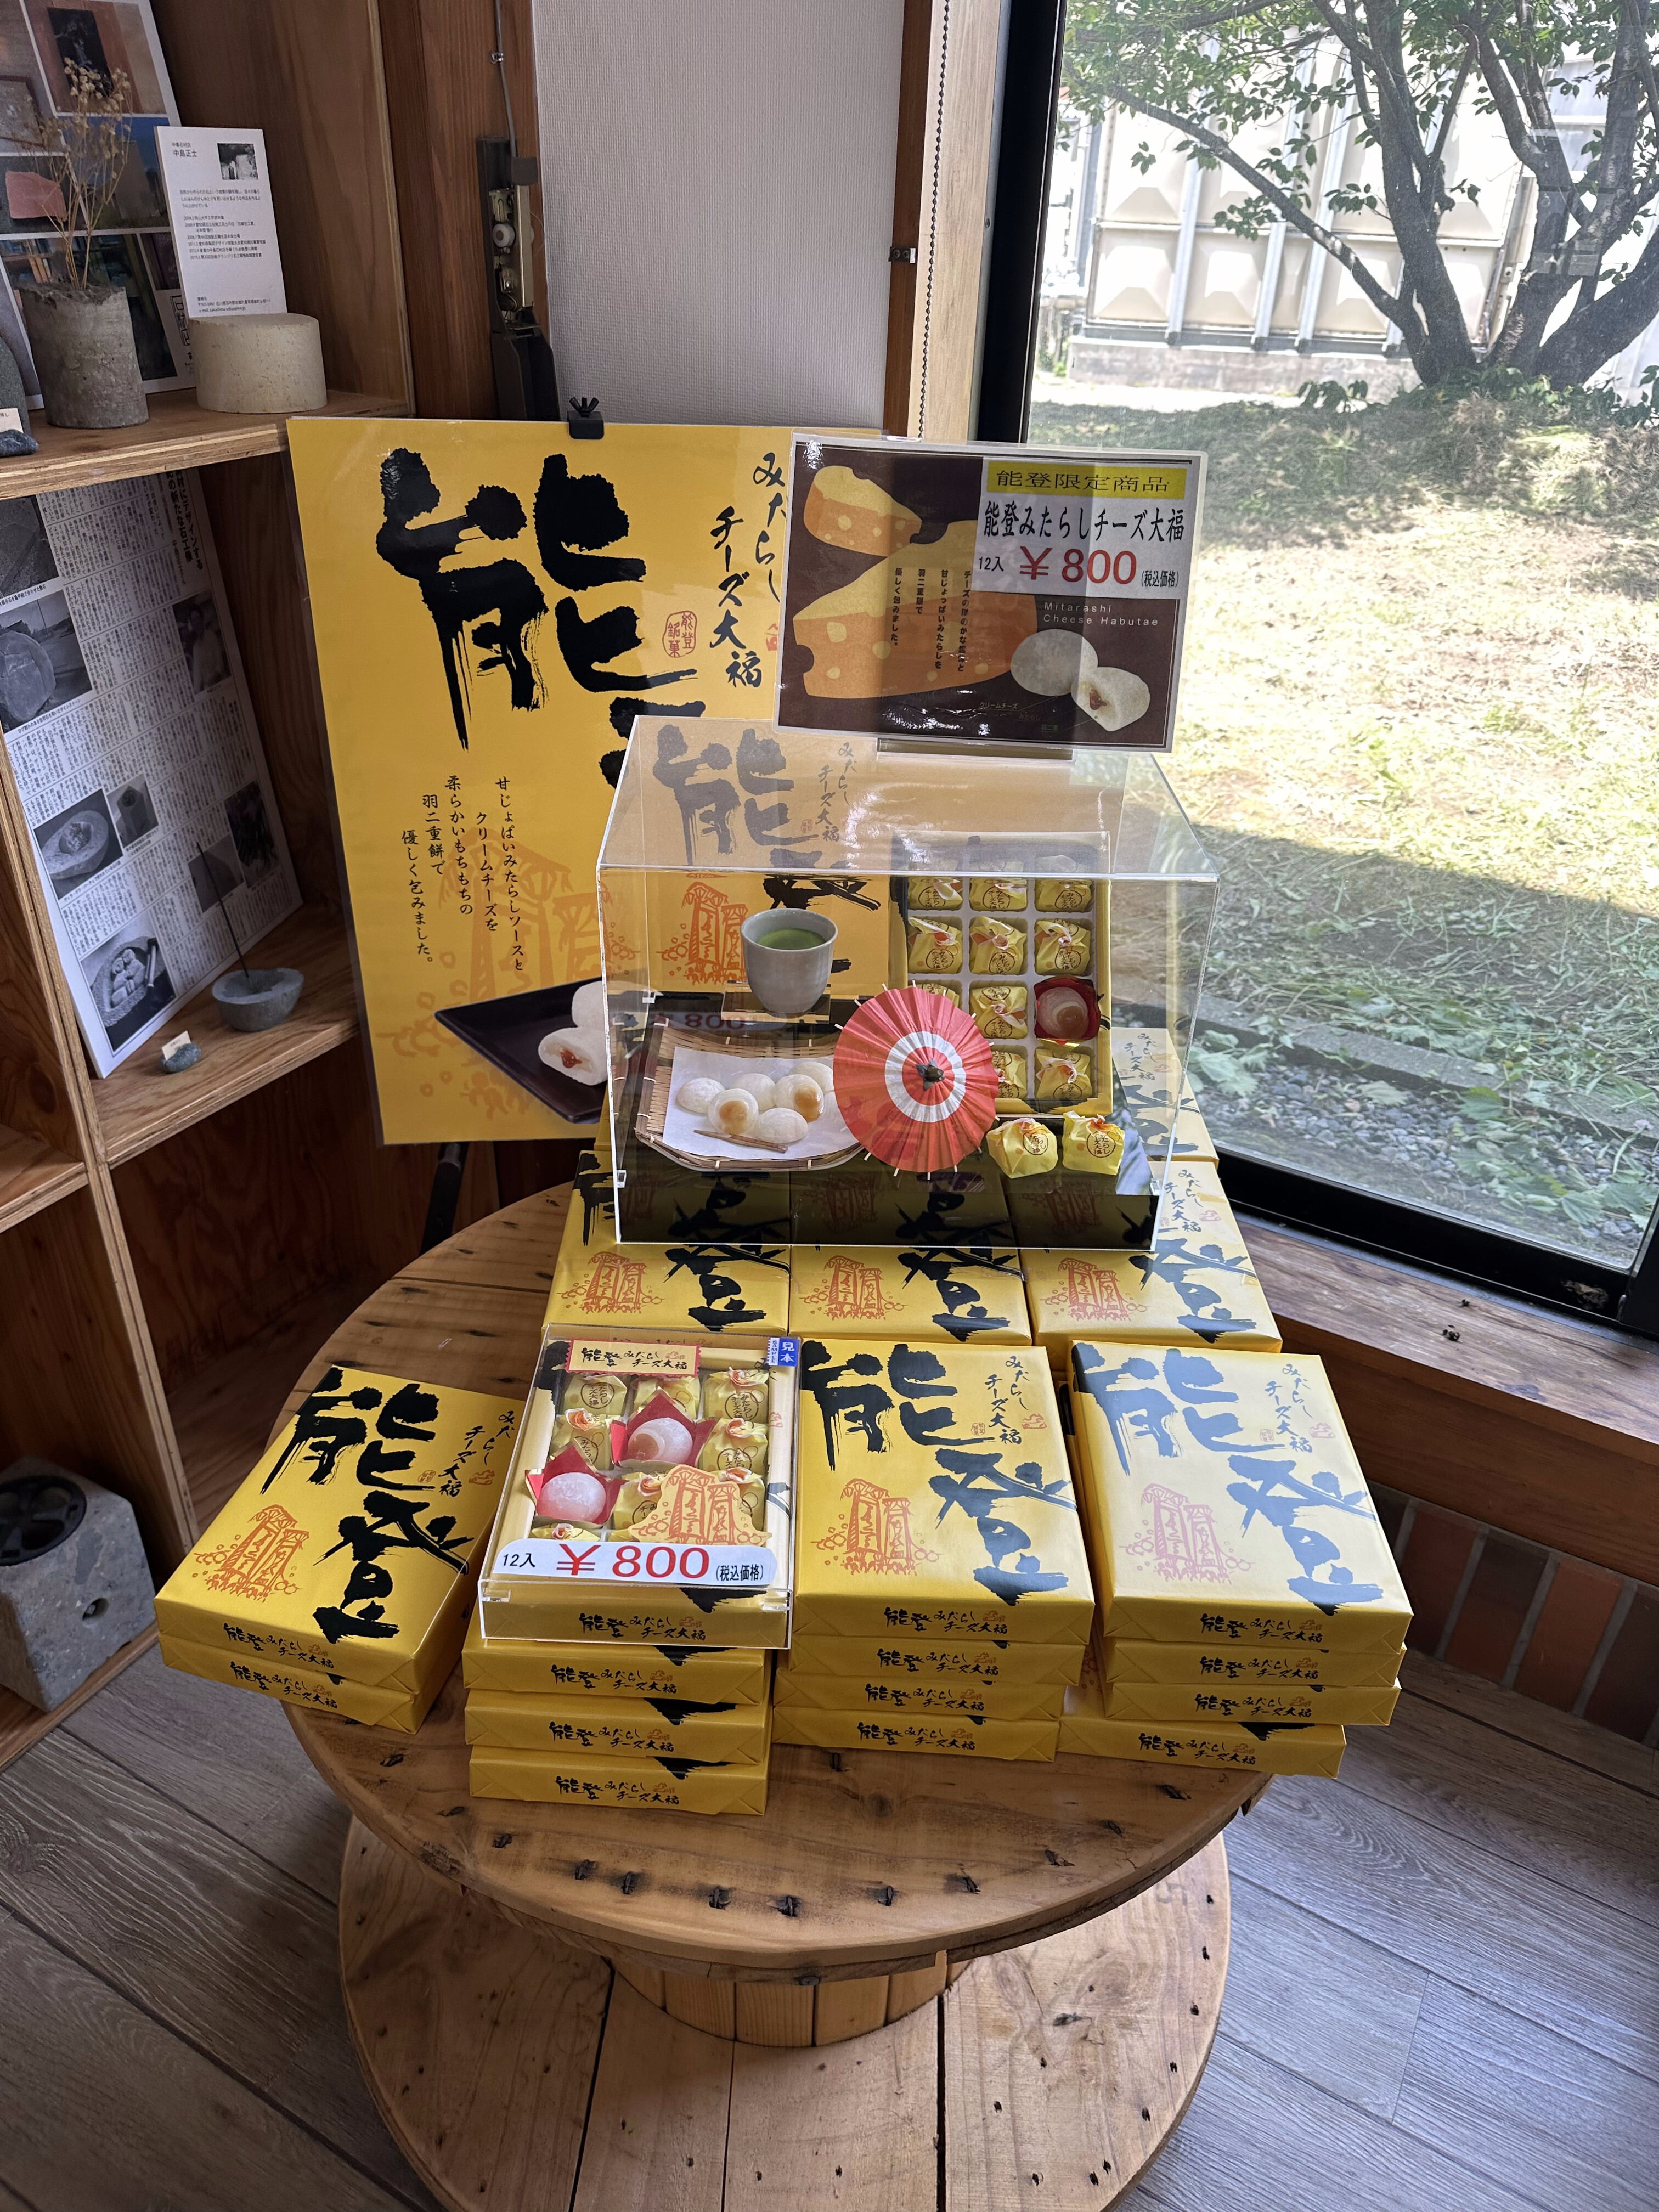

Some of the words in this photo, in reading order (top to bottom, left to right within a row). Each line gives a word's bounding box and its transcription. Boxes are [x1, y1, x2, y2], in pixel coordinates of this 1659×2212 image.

[997, 469, 1169, 493] 能登限定商品
[983, 500, 1185, 543] 能登みたらしチーズ大福
[978, 556, 1005, 572] 12入
[709, 505, 763, 689] チーズ大福
[916, 568, 926, 614] 羽二重餅で
[890, 567, 902, 646] 優しく包みました。
[1044, 602, 1113, 613] Mitarashi
[934, 569, 949, 669] 甘じょっぱいみたらしを
[1043, 613, 1092, 625] Cheese
[1101, 616, 1159, 627] Habutae
[838, 742, 858, 806] みたらし
[814, 764, 840, 843] チーズ大福
[422, 794, 445, 876] 羽二重餅で
[444, 775, 473, 915] 柔らかいもちもちの
[476, 811, 498, 932] クリームチーズを
[401, 828, 433, 963] 優しく包みました。
[1178, 1169, 1203, 1207] みたらし
[1164, 1182, 1202, 1233] チーズ大福
[624, 1349, 659, 1360] みたらし
[780, 1342, 795, 1363] 見本
[632, 1359, 688, 1371] チーズ大福
[1005, 1356, 1031, 1410] みたらし
[1282, 1363, 1313, 1419] みたらし
[984, 1374, 1022, 1444] チーズ大福
[1264, 1380, 1313, 1453] チーズ大福
[482, 1410, 516, 1467] みたらし
[438, 1425, 487, 1497] チーズ大福
[799, 1340, 1078, 1606] 能登
[1071, 1342, 1384, 1617] 能登
[502, 1553, 536, 1568] 12入
[629, 1615, 672, 1628] みたらし
[933, 1610, 975, 1623] みたらし
[943, 1622, 1008, 1634] チーズ大福
[1250, 1618, 1292, 1631] みたらし
[641, 1628, 706, 1641] チーズ大福
[1257, 1630, 1323, 1644] チーズ大福
[926, 1652, 966, 1664] みたらし
[1248, 1659, 1289, 1672] みたらし
[601, 1669, 641, 1681] みたらし
[935, 1663, 999, 1676] チーズ大福
[1255, 1668, 1319, 1680] チーズ大福
[613, 1680, 677, 1694] チーズ大福
[912, 1688, 952, 1700] みたらし
[922, 1699, 985, 1712] チーズ大福
[1242, 1696, 1282, 1708] みたらし
[1250, 1705, 1312, 1718] チーズ大福
[599, 1726, 640, 1739] みたらし
[904, 1726, 945, 1739] みたらし
[610, 1738, 674, 1753] チーズ大福
[914, 1737, 975, 1751] チーズ大福
[1186, 1739, 1226, 1752] みたらし
[1194, 1750, 1256, 1766] チーズ大福
[604, 1781, 646, 1793] みたらし
[616, 1792, 680, 1805] チーズ大福
